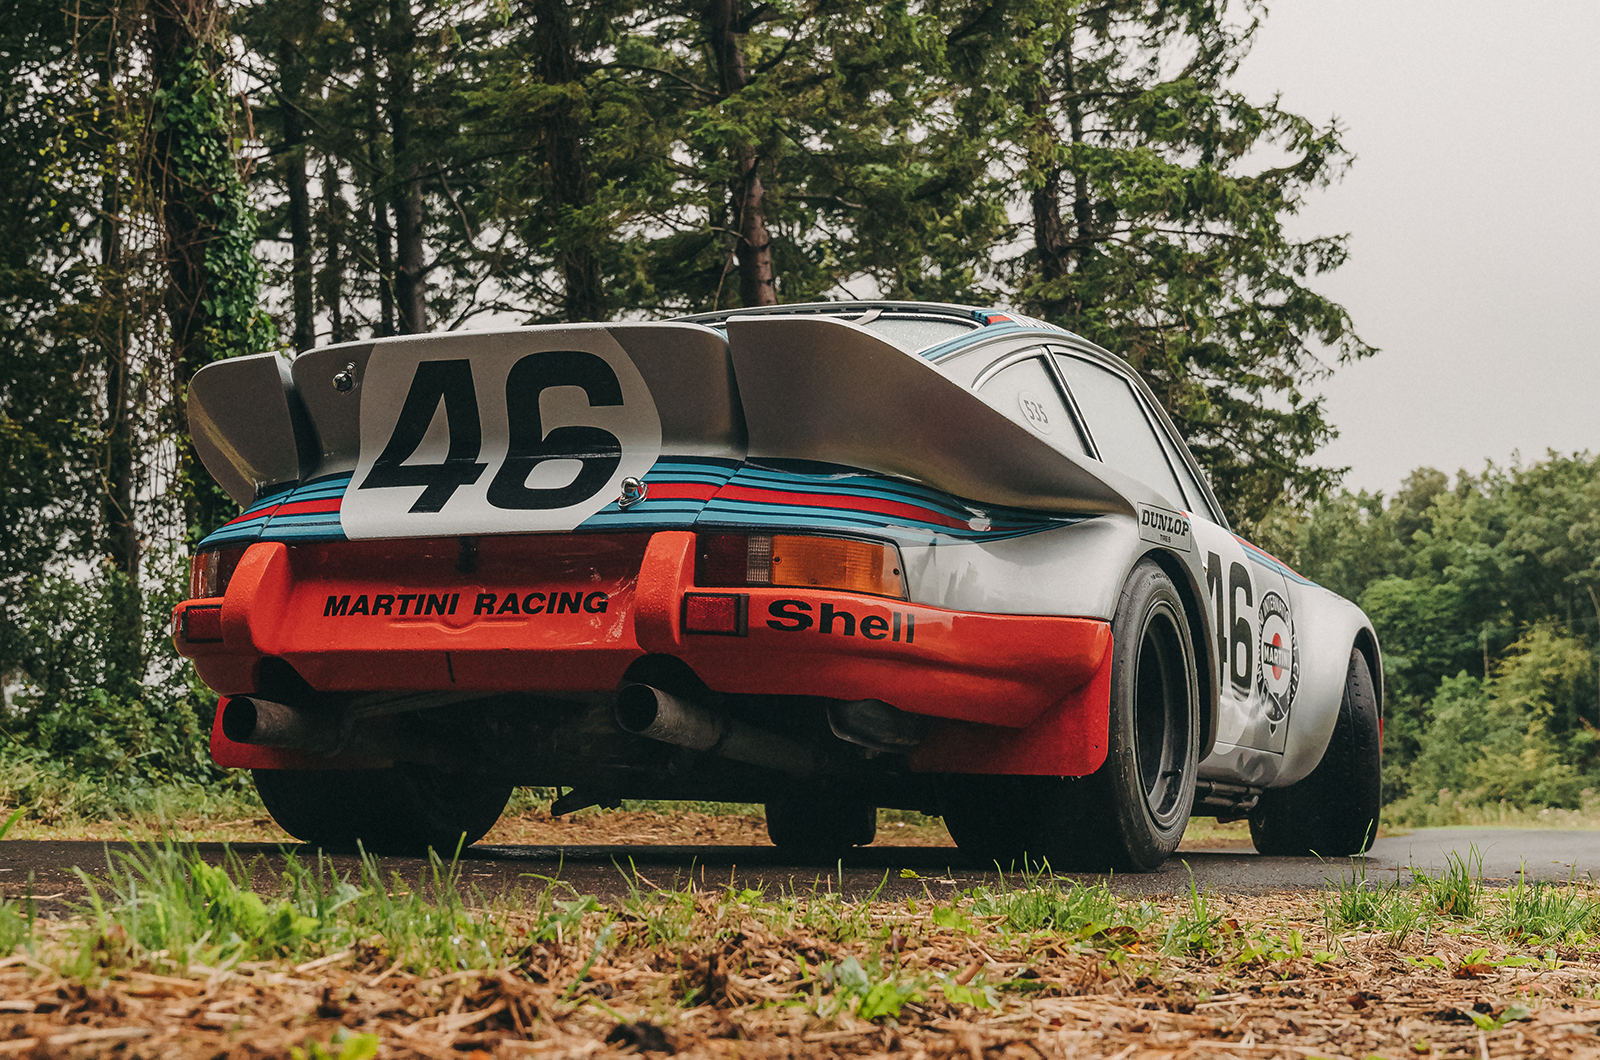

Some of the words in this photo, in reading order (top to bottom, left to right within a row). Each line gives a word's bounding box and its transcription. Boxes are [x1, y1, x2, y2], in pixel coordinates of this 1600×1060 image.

[1023, 399, 1049, 424] 535
[357, 350, 625, 514] 46
[1141, 508, 1189, 537] DUNLOP
[323, 593, 460, 617] MARTINI
[473, 591, 609, 615] RACING
[766, 599, 915, 644] Shell
[1206, 550, 1253, 702] 46
